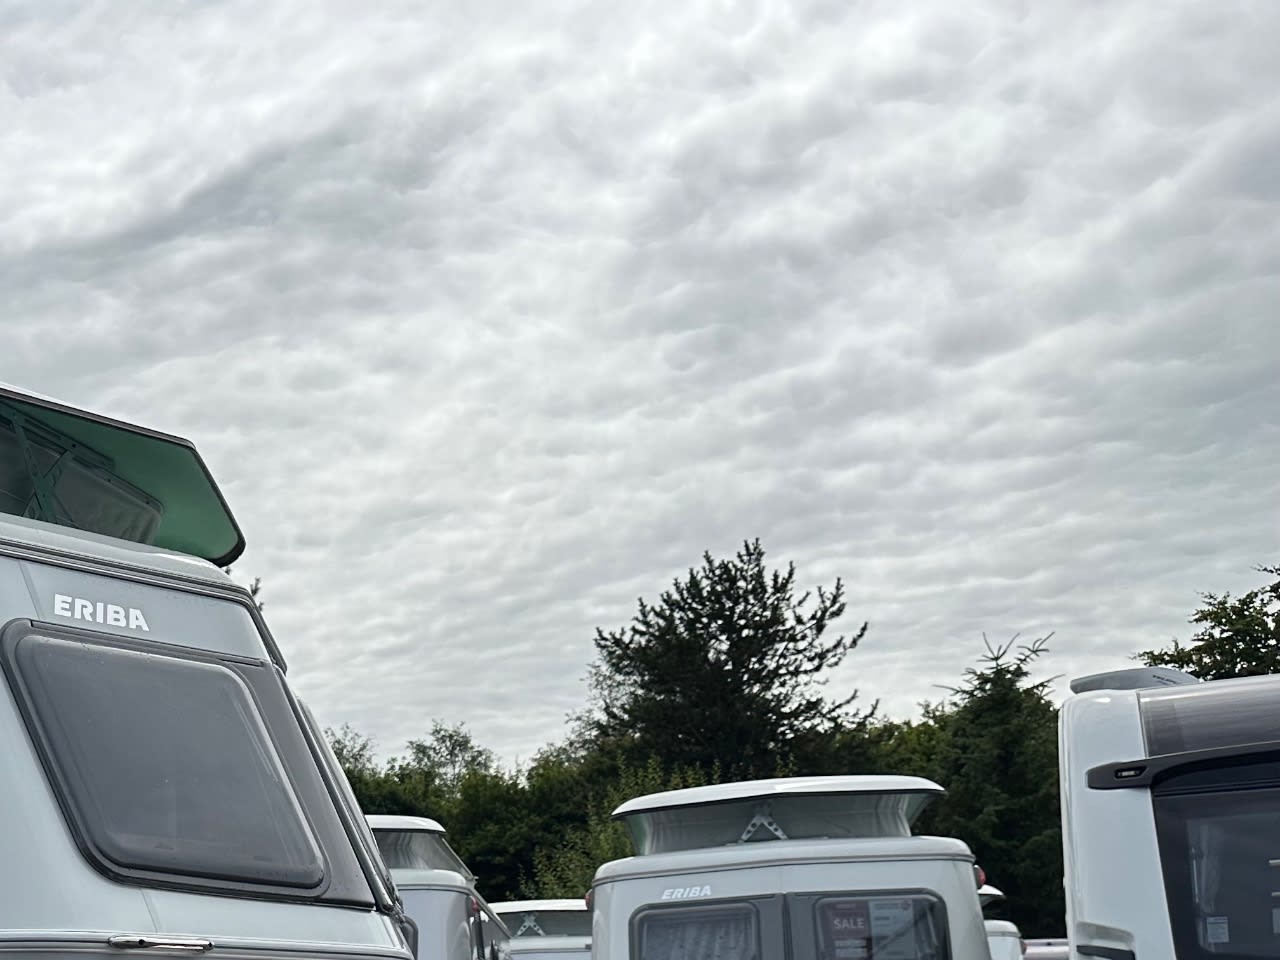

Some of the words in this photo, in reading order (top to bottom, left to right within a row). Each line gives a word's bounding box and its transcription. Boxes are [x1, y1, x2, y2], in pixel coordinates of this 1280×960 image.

[54, 593, 150, 632] ERIBA
[661, 884, 712, 900] ERIBA
[833, 917, 865, 929] SALE
